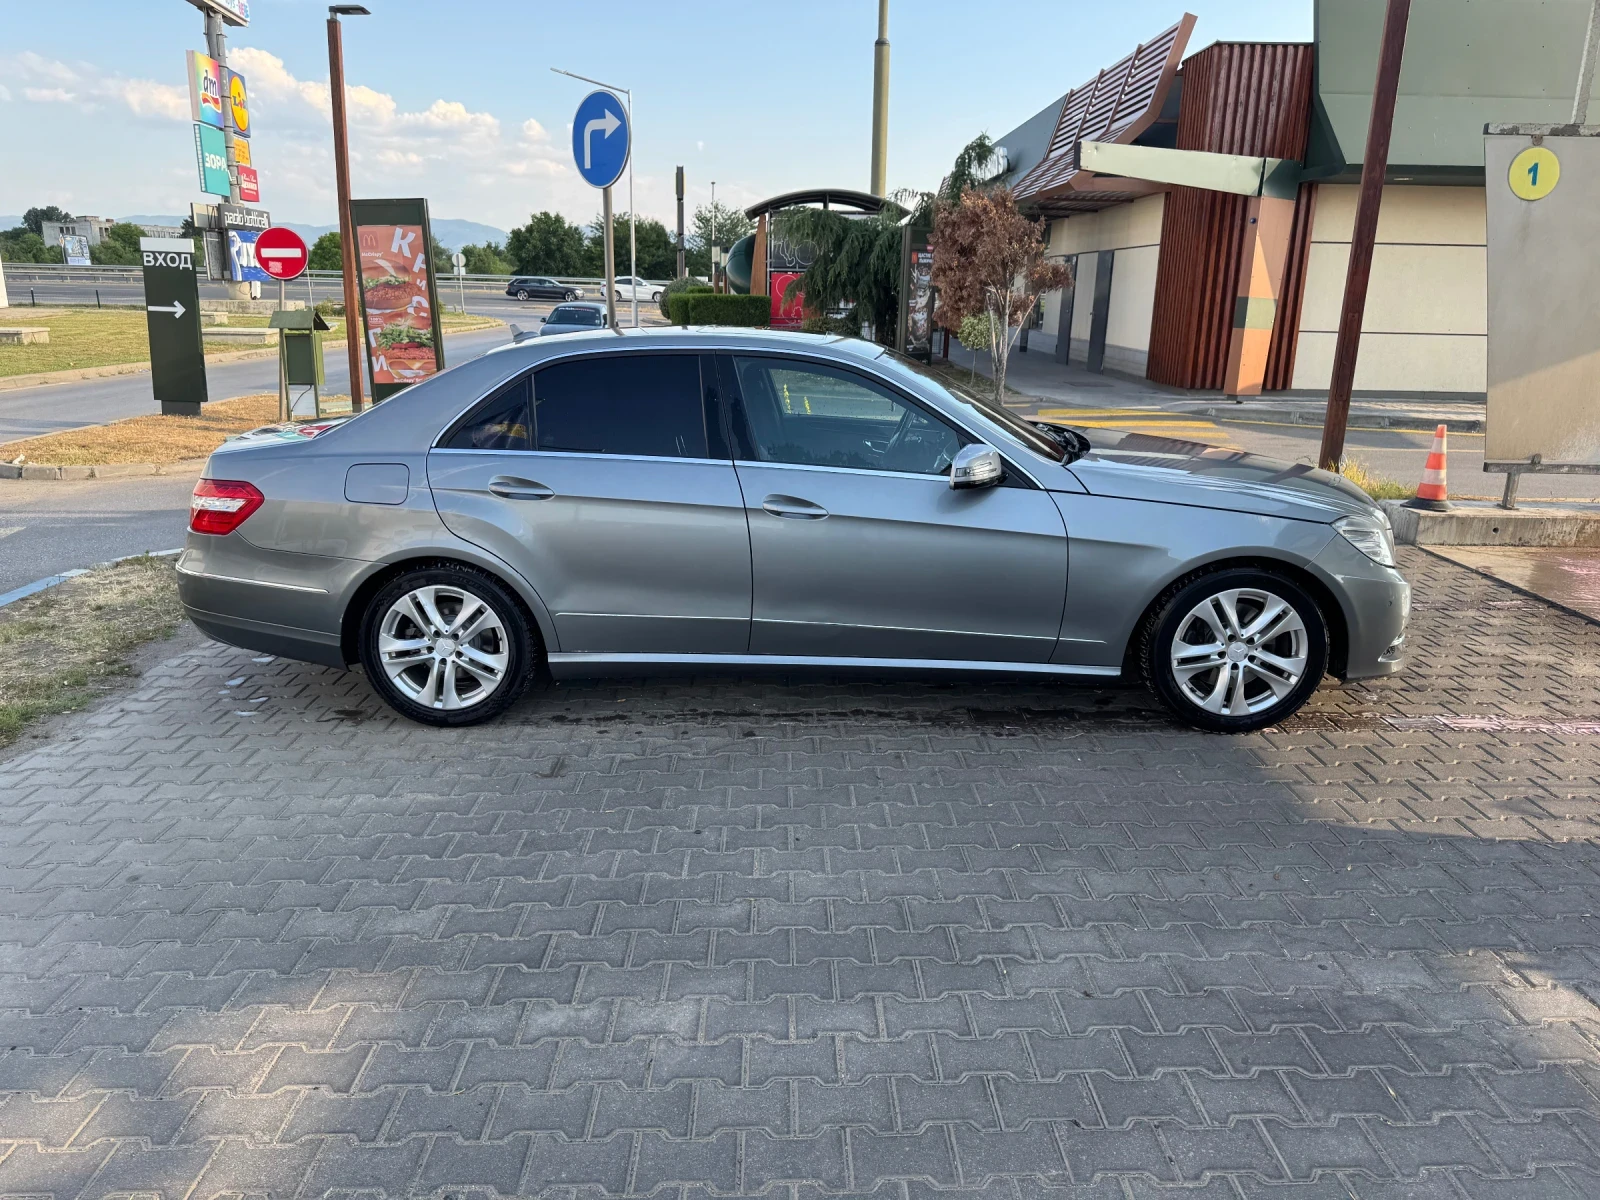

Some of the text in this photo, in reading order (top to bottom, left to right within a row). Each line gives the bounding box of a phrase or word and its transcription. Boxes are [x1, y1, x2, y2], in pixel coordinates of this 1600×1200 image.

[203, 70, 217, 97] dm
[205, 152, 228, 171] ЗОРА
[1527, 161, 1540, 187] 1
[224, 209, 244, 227] paolo
[143, 252, 192, 270] ВХОД
